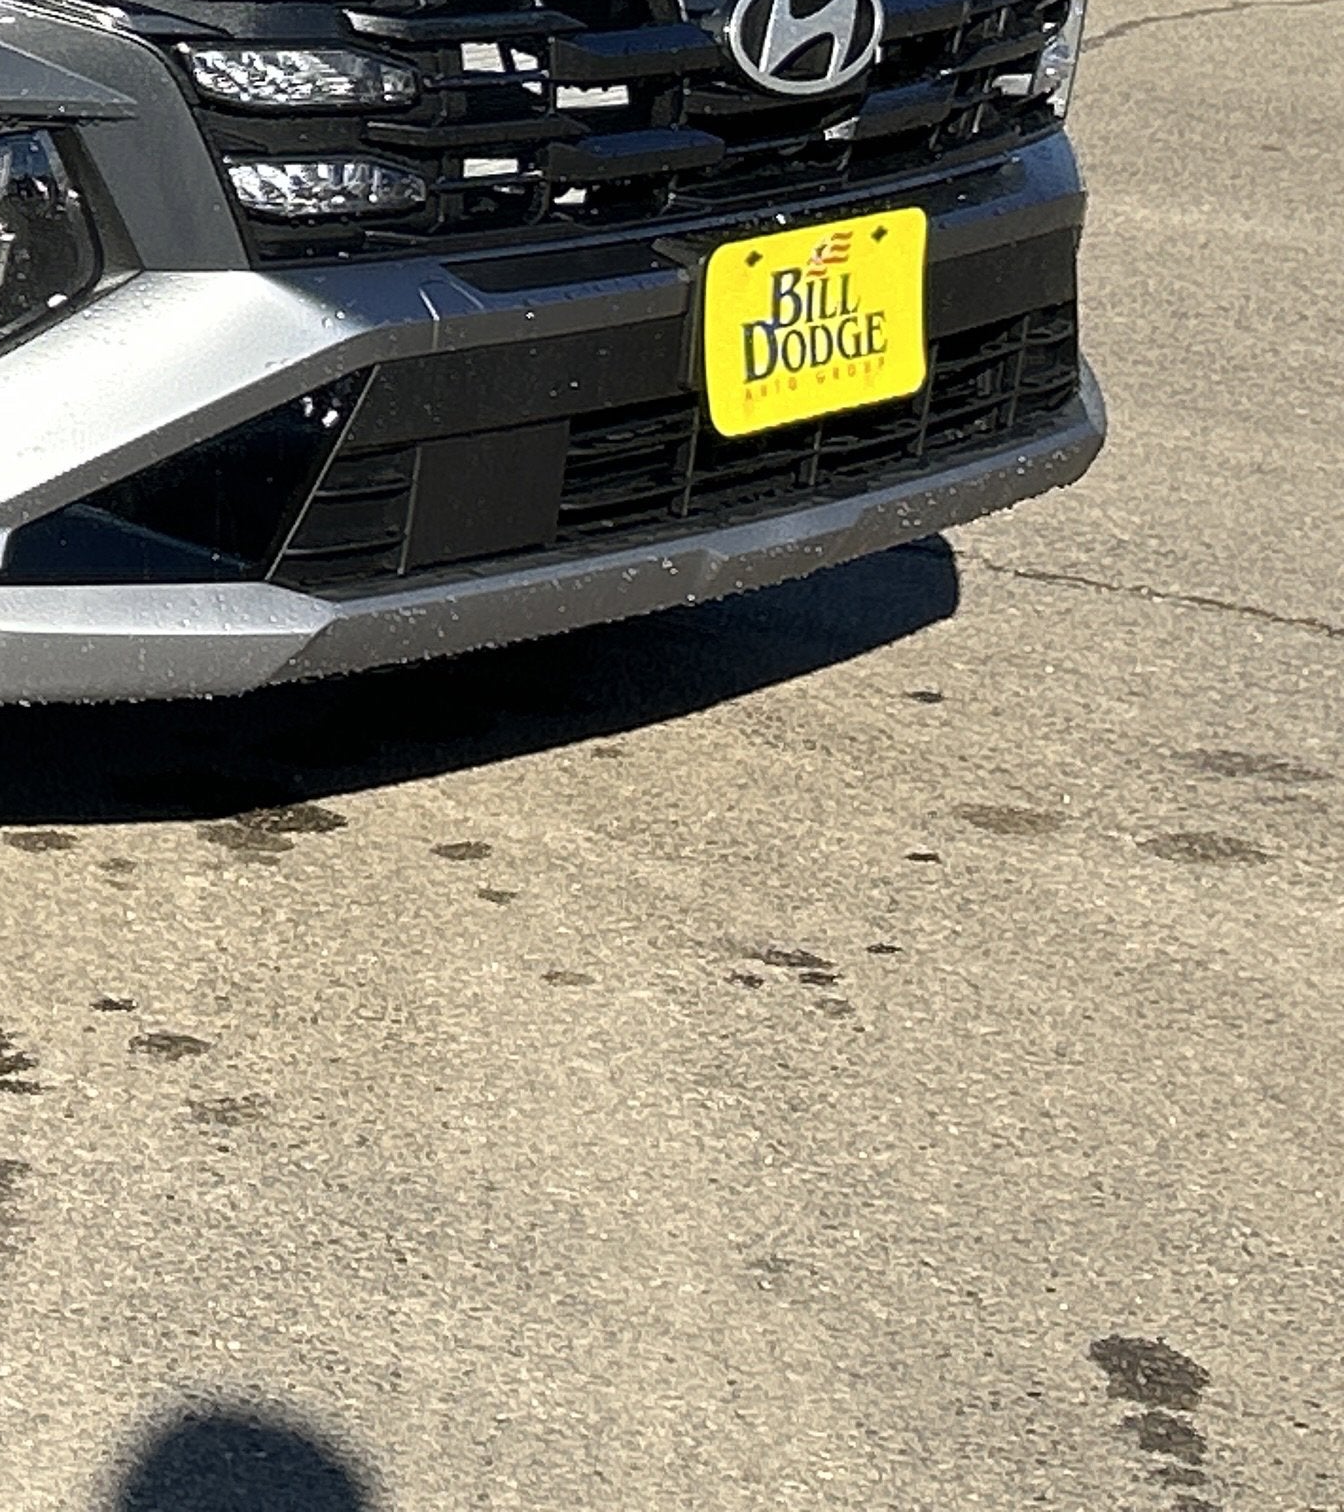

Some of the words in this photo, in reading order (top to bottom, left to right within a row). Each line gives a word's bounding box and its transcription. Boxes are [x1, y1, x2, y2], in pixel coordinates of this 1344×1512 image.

[771, 268, 860, 330] BILL
[741, 311, 888, 384] DODGE
[745, 377, 798, 400] AUTO
[815, 356, 885, 384] GROUP
